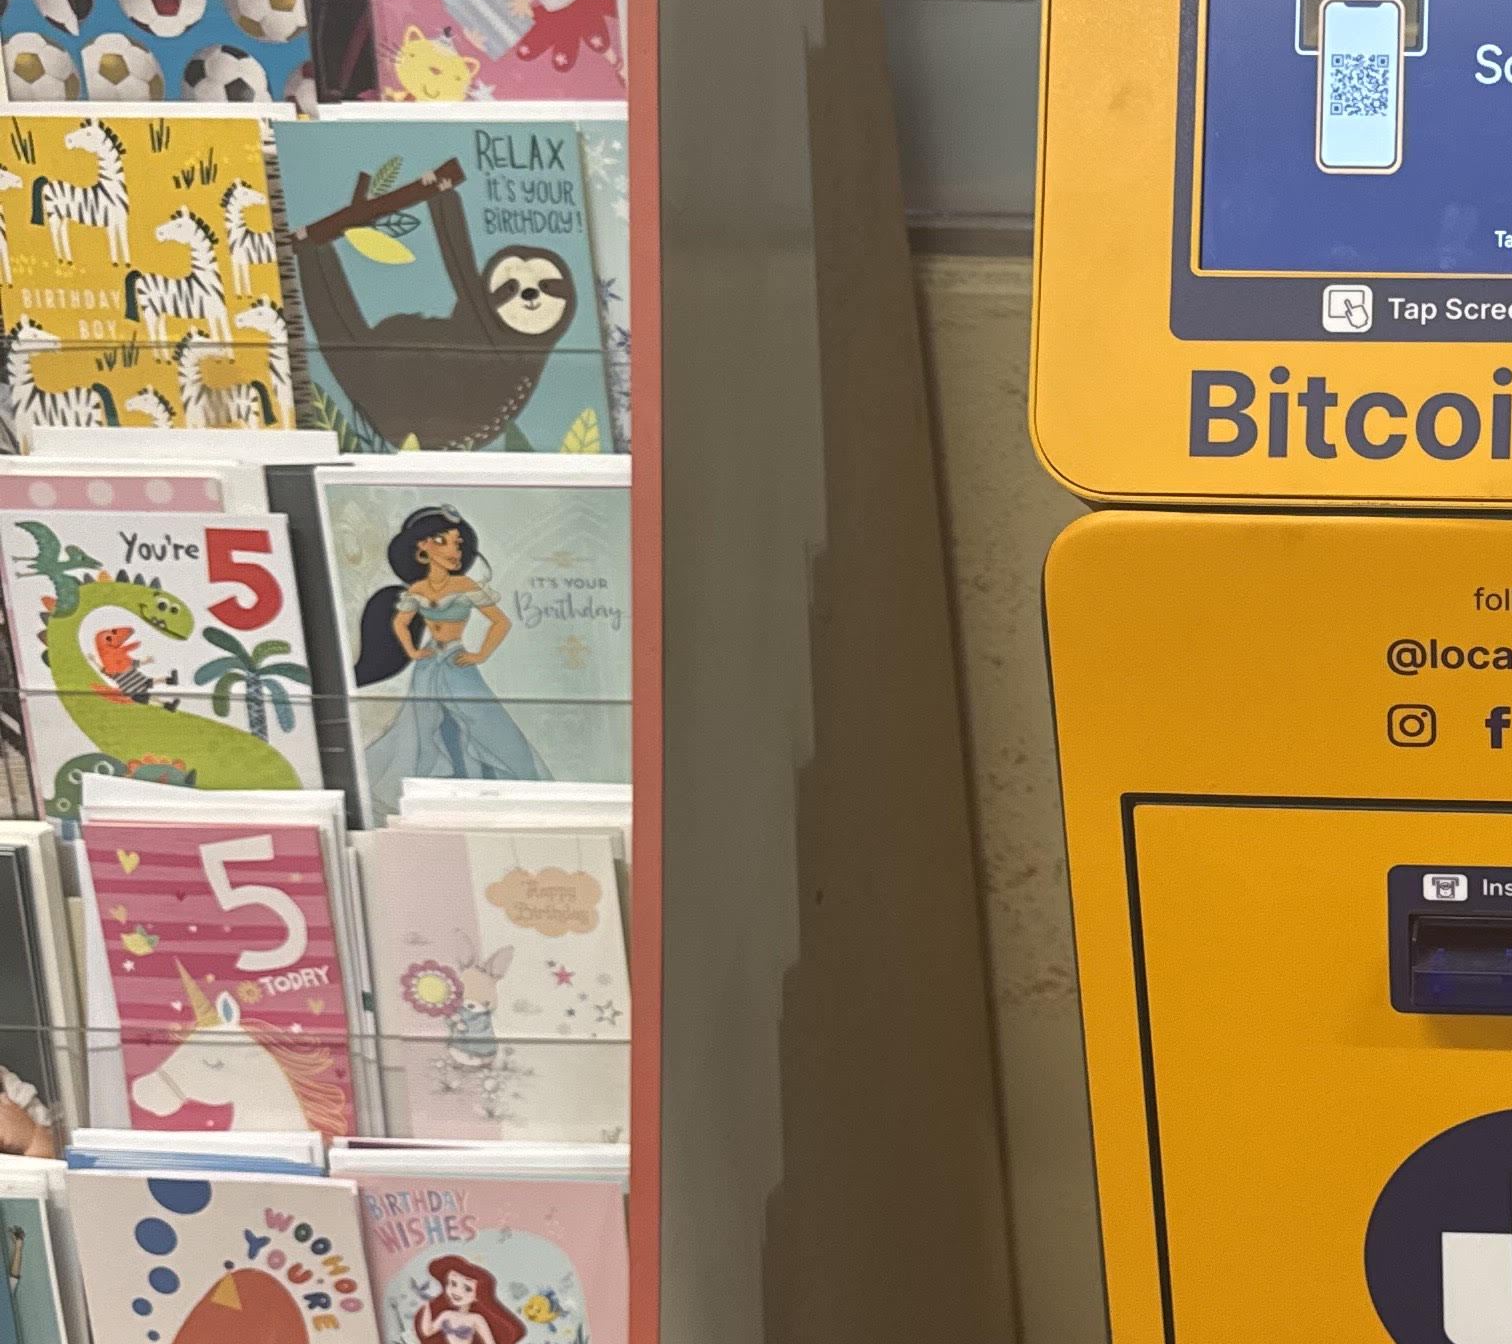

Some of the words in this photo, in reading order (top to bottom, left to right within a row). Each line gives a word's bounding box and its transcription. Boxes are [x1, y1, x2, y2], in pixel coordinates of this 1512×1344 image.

[474, 129, 565, 171] RELAX
[22, 287, 121, 311] BIRTHDAY
[1388, 297, 1437, 327] Tap
[78, 319, 118, 341] BOY
[119, 530, 200, 564] You're
[205, 527, 284, 632] 5
[563, 577, 609, 590] YOUR
[513, 589, 623, 631] Birthday
[199, 834, 308, 971] 5
[363, 1190, 467, 1222] BIRTHDAY
[373, 1214, 478, 1254] WISHES
